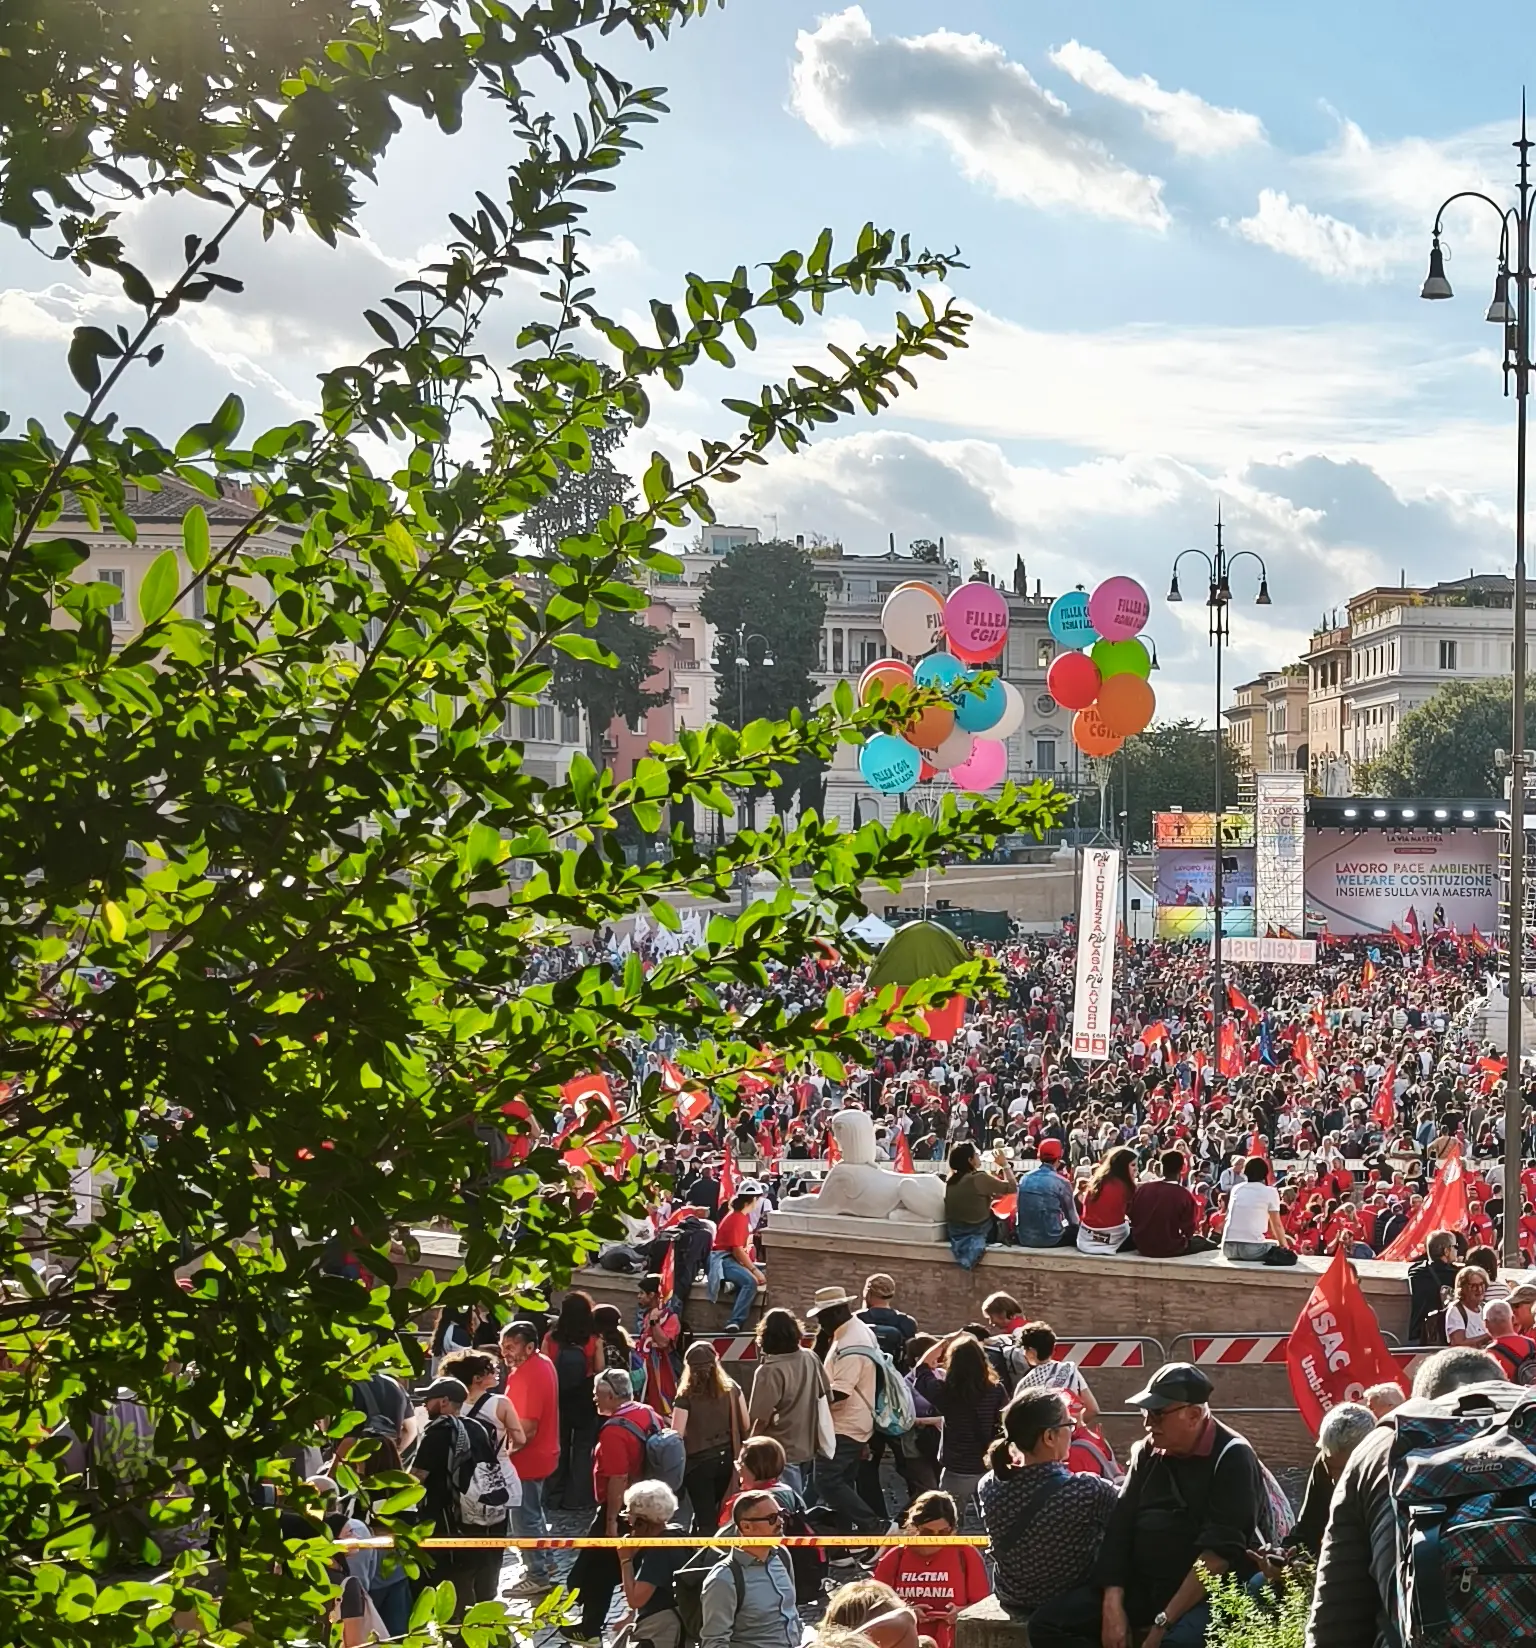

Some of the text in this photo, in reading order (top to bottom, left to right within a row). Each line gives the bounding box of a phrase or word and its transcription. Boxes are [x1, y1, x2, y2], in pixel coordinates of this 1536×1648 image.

[965, 610, 1007, 628] FILLEA
[970, 628, 1000, 642] CGIL
[1090, 723, 1121, 739] CGIL
[1335, 863, 1493, 874] LAVORO PACE AMBIENTE
[1336, 875, 1493, 886] WELFARE COSTITUZIONE
[1336, 887, 1493, 897] INSIEME SULLA VIA MAESTRA
[1090, 941, 1101, 973] CASA
[1086, 981, 1099, 1030] LAVORO
[1307, 1285, 1351, 1373] FISAC
[1301, 1354, 1335, 1412] Umbria
[901, 1571, 949, 1582] FILCTEM
